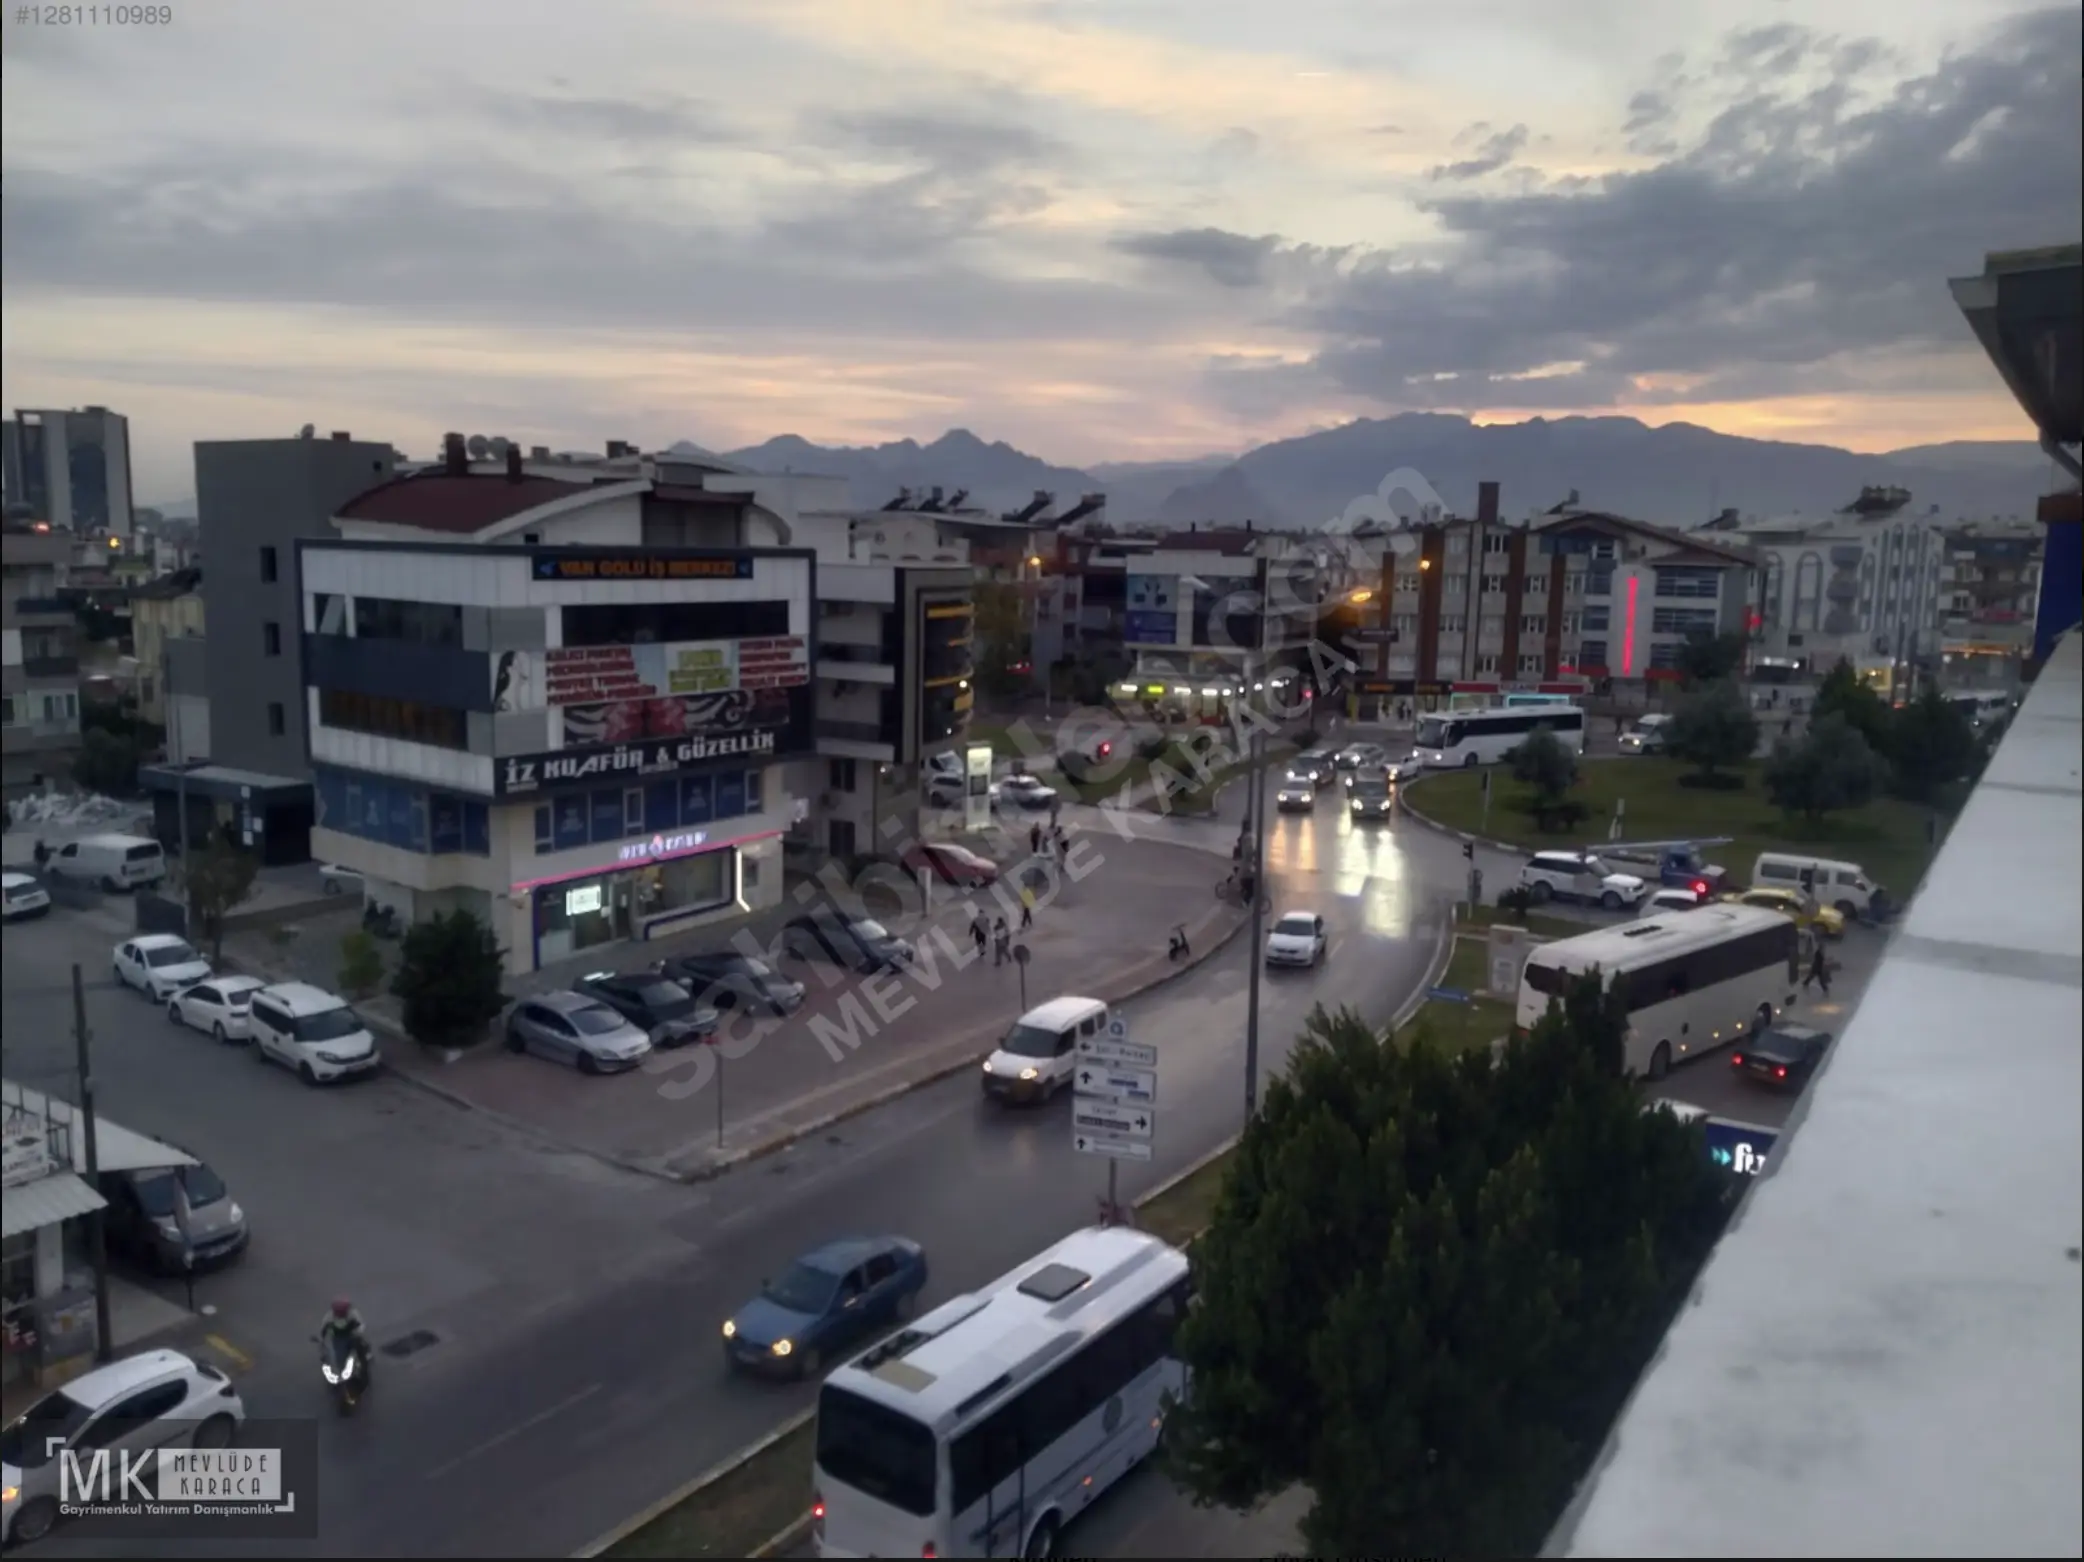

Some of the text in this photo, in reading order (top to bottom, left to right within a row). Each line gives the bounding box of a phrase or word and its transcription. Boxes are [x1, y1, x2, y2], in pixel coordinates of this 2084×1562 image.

[504, 759, 538, 784] İZ
[543, 747, 644, 779] KUAFÖR
[656, 747, 671, 763] &
[676, 731, 775, 761] GÜZELLİK
